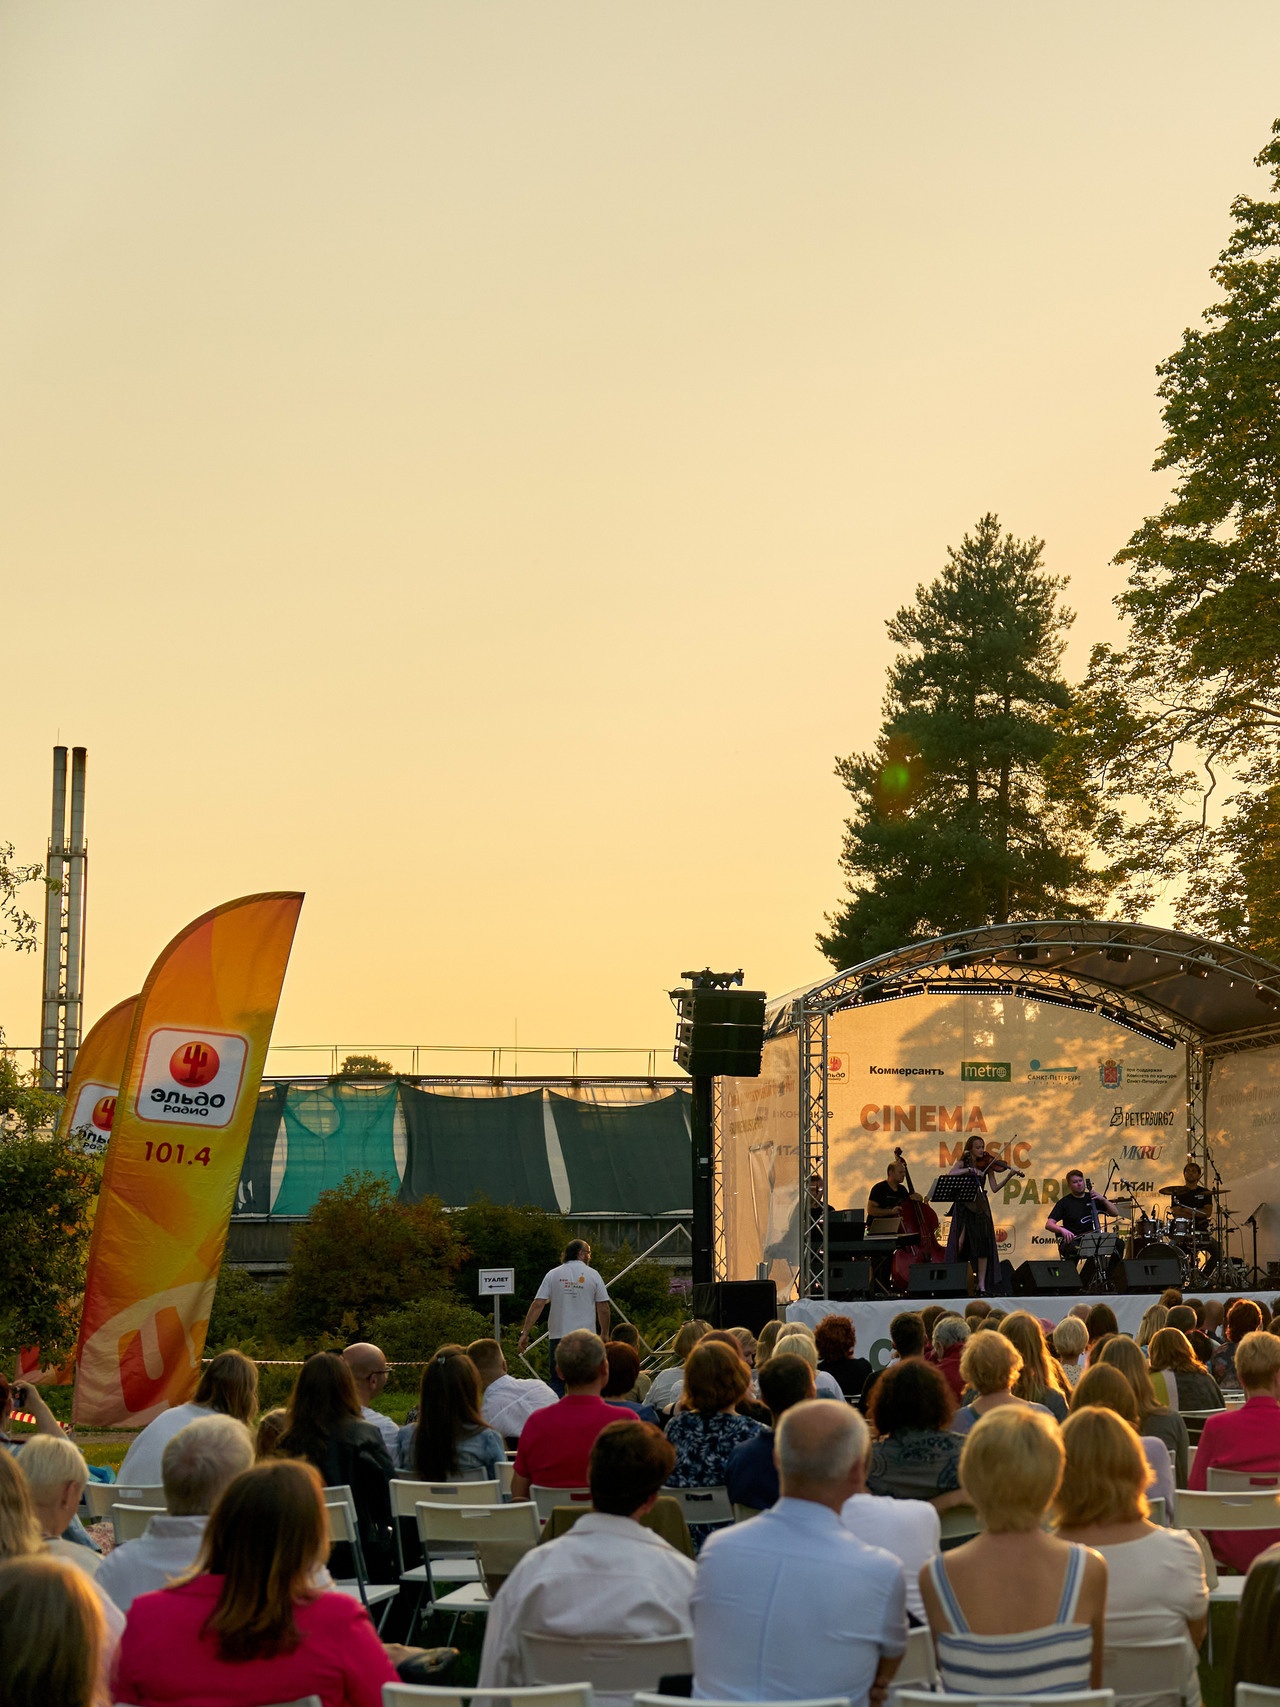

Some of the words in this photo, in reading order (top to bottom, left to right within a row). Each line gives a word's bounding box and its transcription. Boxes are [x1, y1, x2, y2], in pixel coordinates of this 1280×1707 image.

[868, 1065, 945, 1077] Коммерсантъ
[964, 1064, 1007, 1078] metro
[860, 1103, 988, 1133] CINEMA
[145, 1141, 211, 1167] 101.4
[1003, 1178, 1069, 1204] PAR
